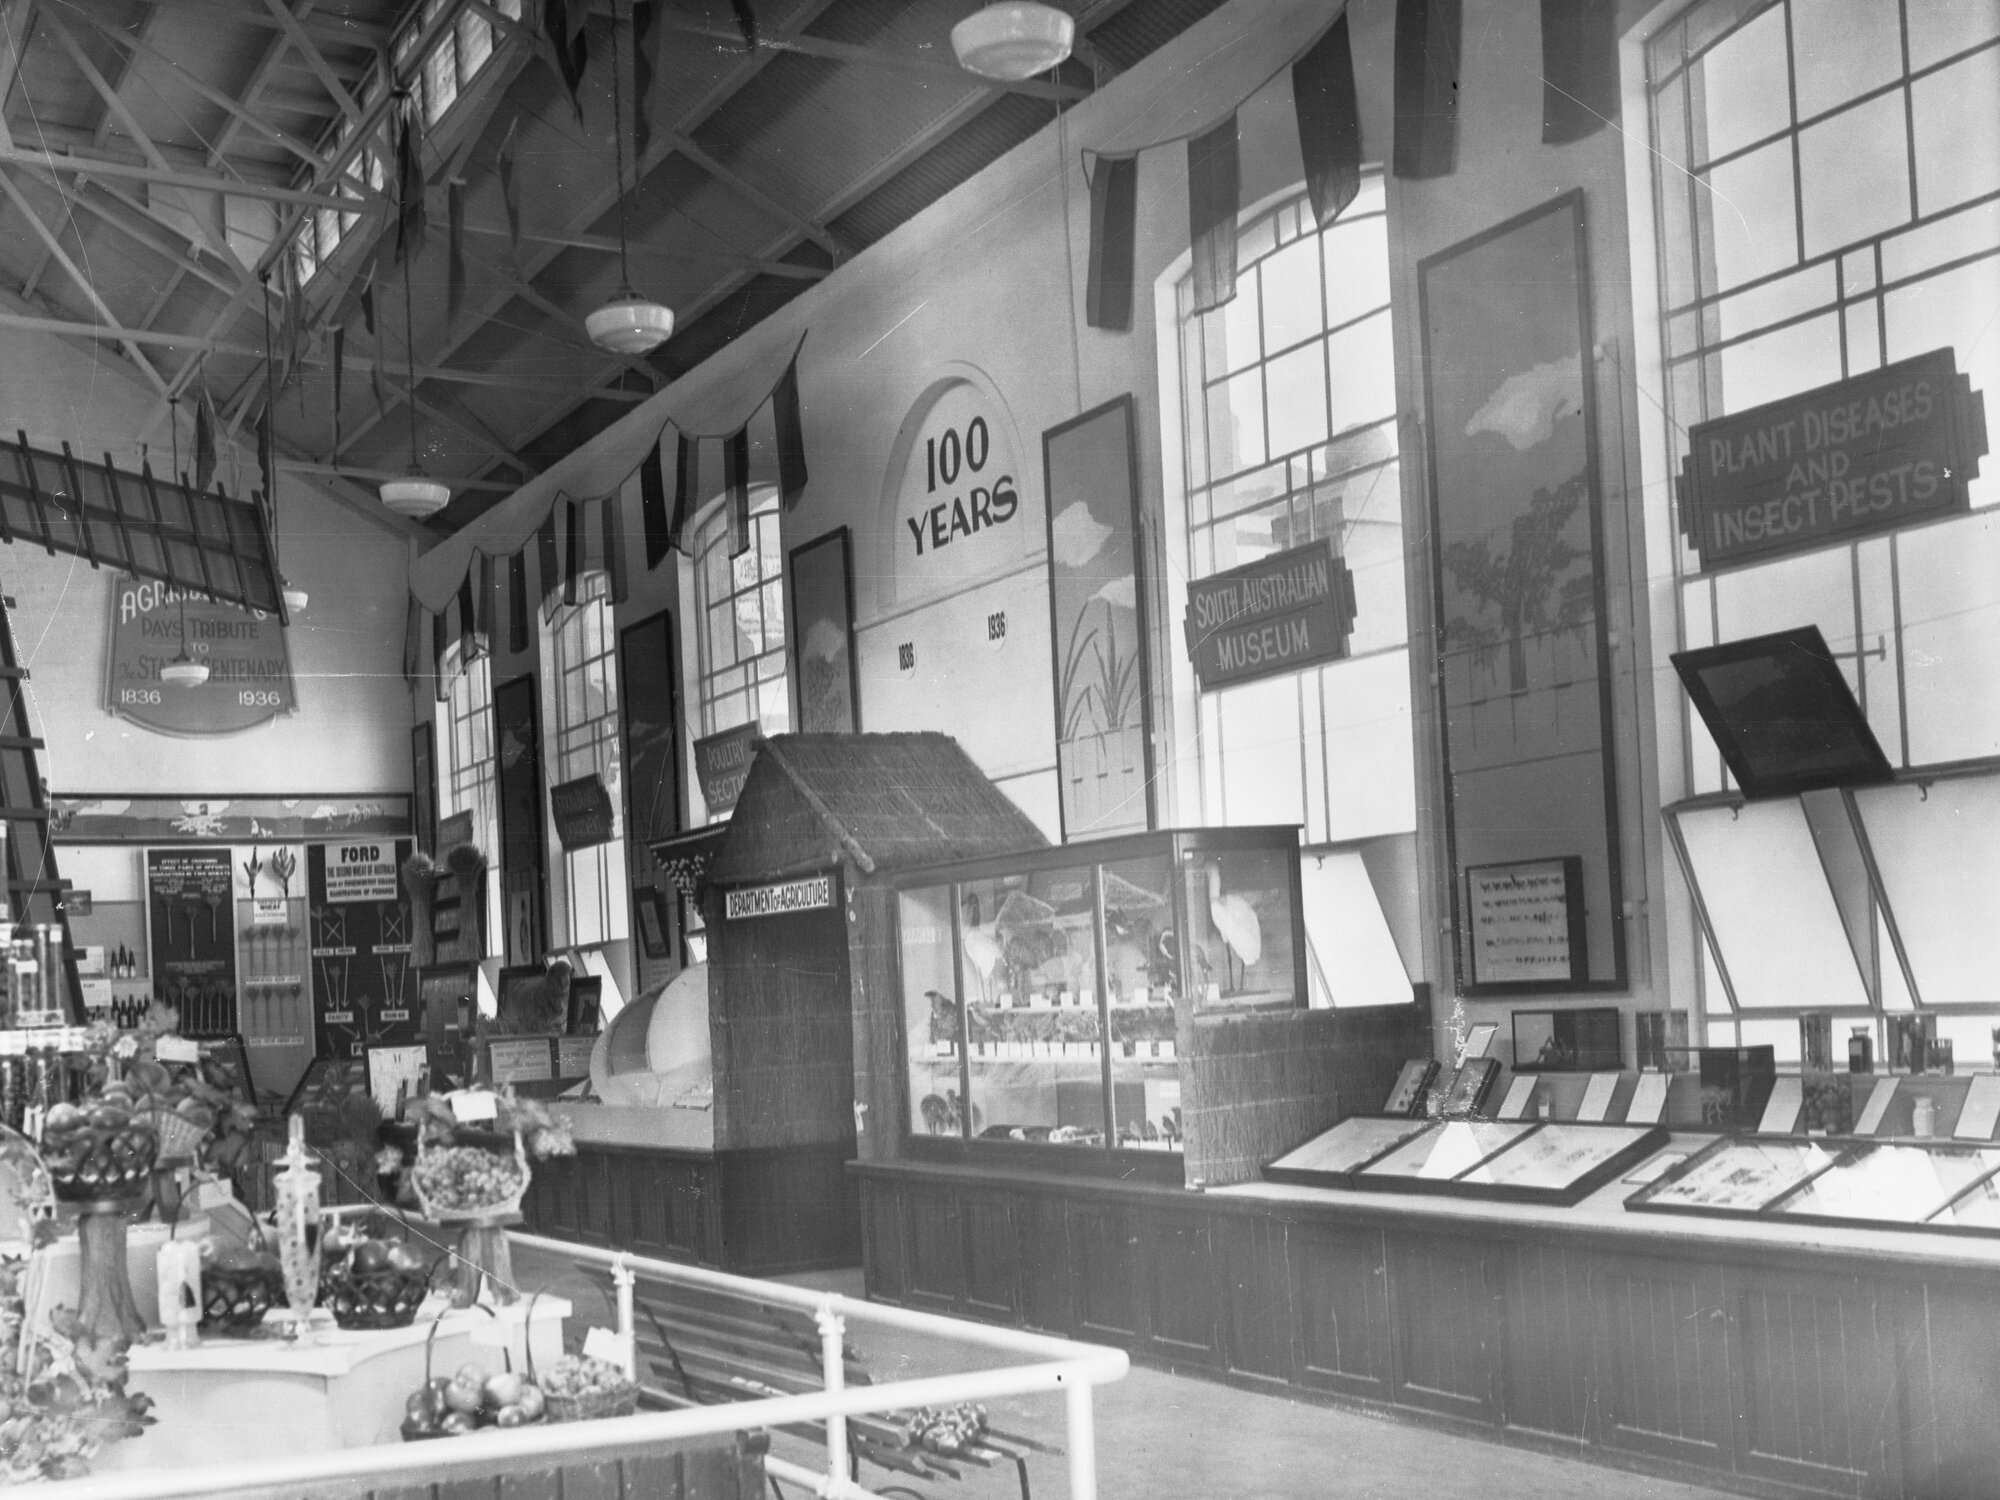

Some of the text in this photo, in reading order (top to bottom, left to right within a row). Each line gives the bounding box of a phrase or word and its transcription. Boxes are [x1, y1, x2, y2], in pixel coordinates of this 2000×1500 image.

[1708, 381, 1933, 477] PLANT DISEASES
[927, 415, 989, 494] 100
[1786, 451, 1851, 492] AND
[907, 474, 1018, 556] YEARS
[1711, 458, 1939, 550] INSECT PESTS
[1195, 558, 1329, 630] SOUTH AUSTRALIAN
[141, 617, 260, 640] PAYS TRIBUTE
[987, 610, 1006, 642] 1936
[1216, 617, 1310, 673] MUSEUM
[191, 642, 210, 655] TO
[898, 641, 915, 672] 1836
[121, 689, 281, 706] 1836 1936
[706, 736, 745, 771] POULTRY
[341, 845, 380, 863] FORD
[729, 888, 774, 917] DEPARTMENT
[781, 879, 829, 911] AGRICULTURE
